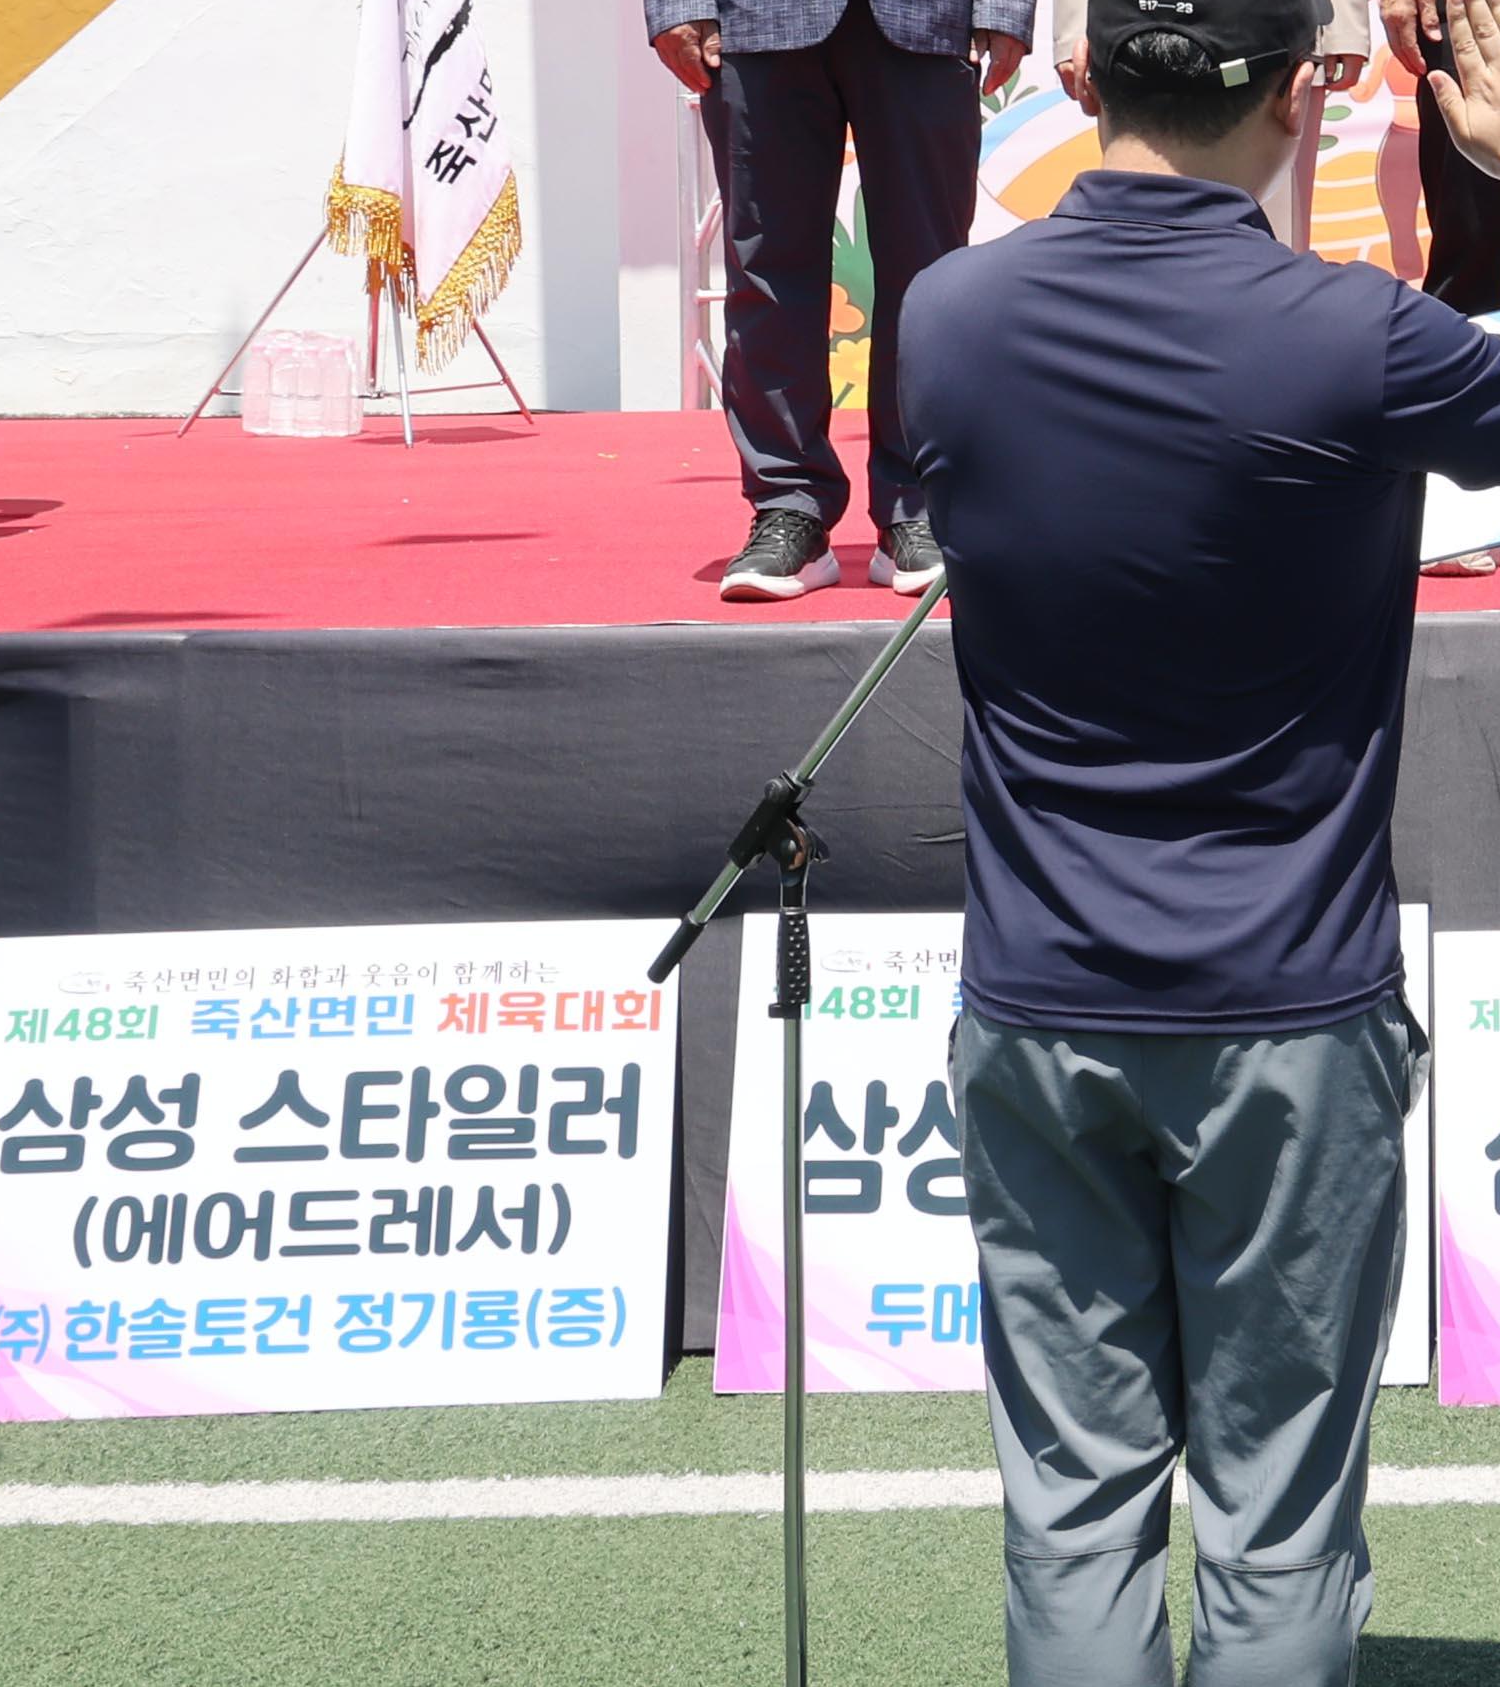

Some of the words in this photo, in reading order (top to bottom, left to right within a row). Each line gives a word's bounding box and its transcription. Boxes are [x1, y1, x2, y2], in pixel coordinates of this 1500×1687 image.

[124, 965, 256, 994] 죽산면민의
[269, 964, 350, 990] 화합과
[362, 961, 440, 989] 웃음이
[452, 958, 561, 986] 함께하는
[774, 984, 921, 1021] 48회
[4, 1004, 160, 1044] 제48회
[190, 993, 415, 1041] 죽산면민
[437, 988, 663, 1035] 체육대회
[233, 1062, 642, 1164] 스타일러
[73, 1182, 573, 1269] (에어드레서)
